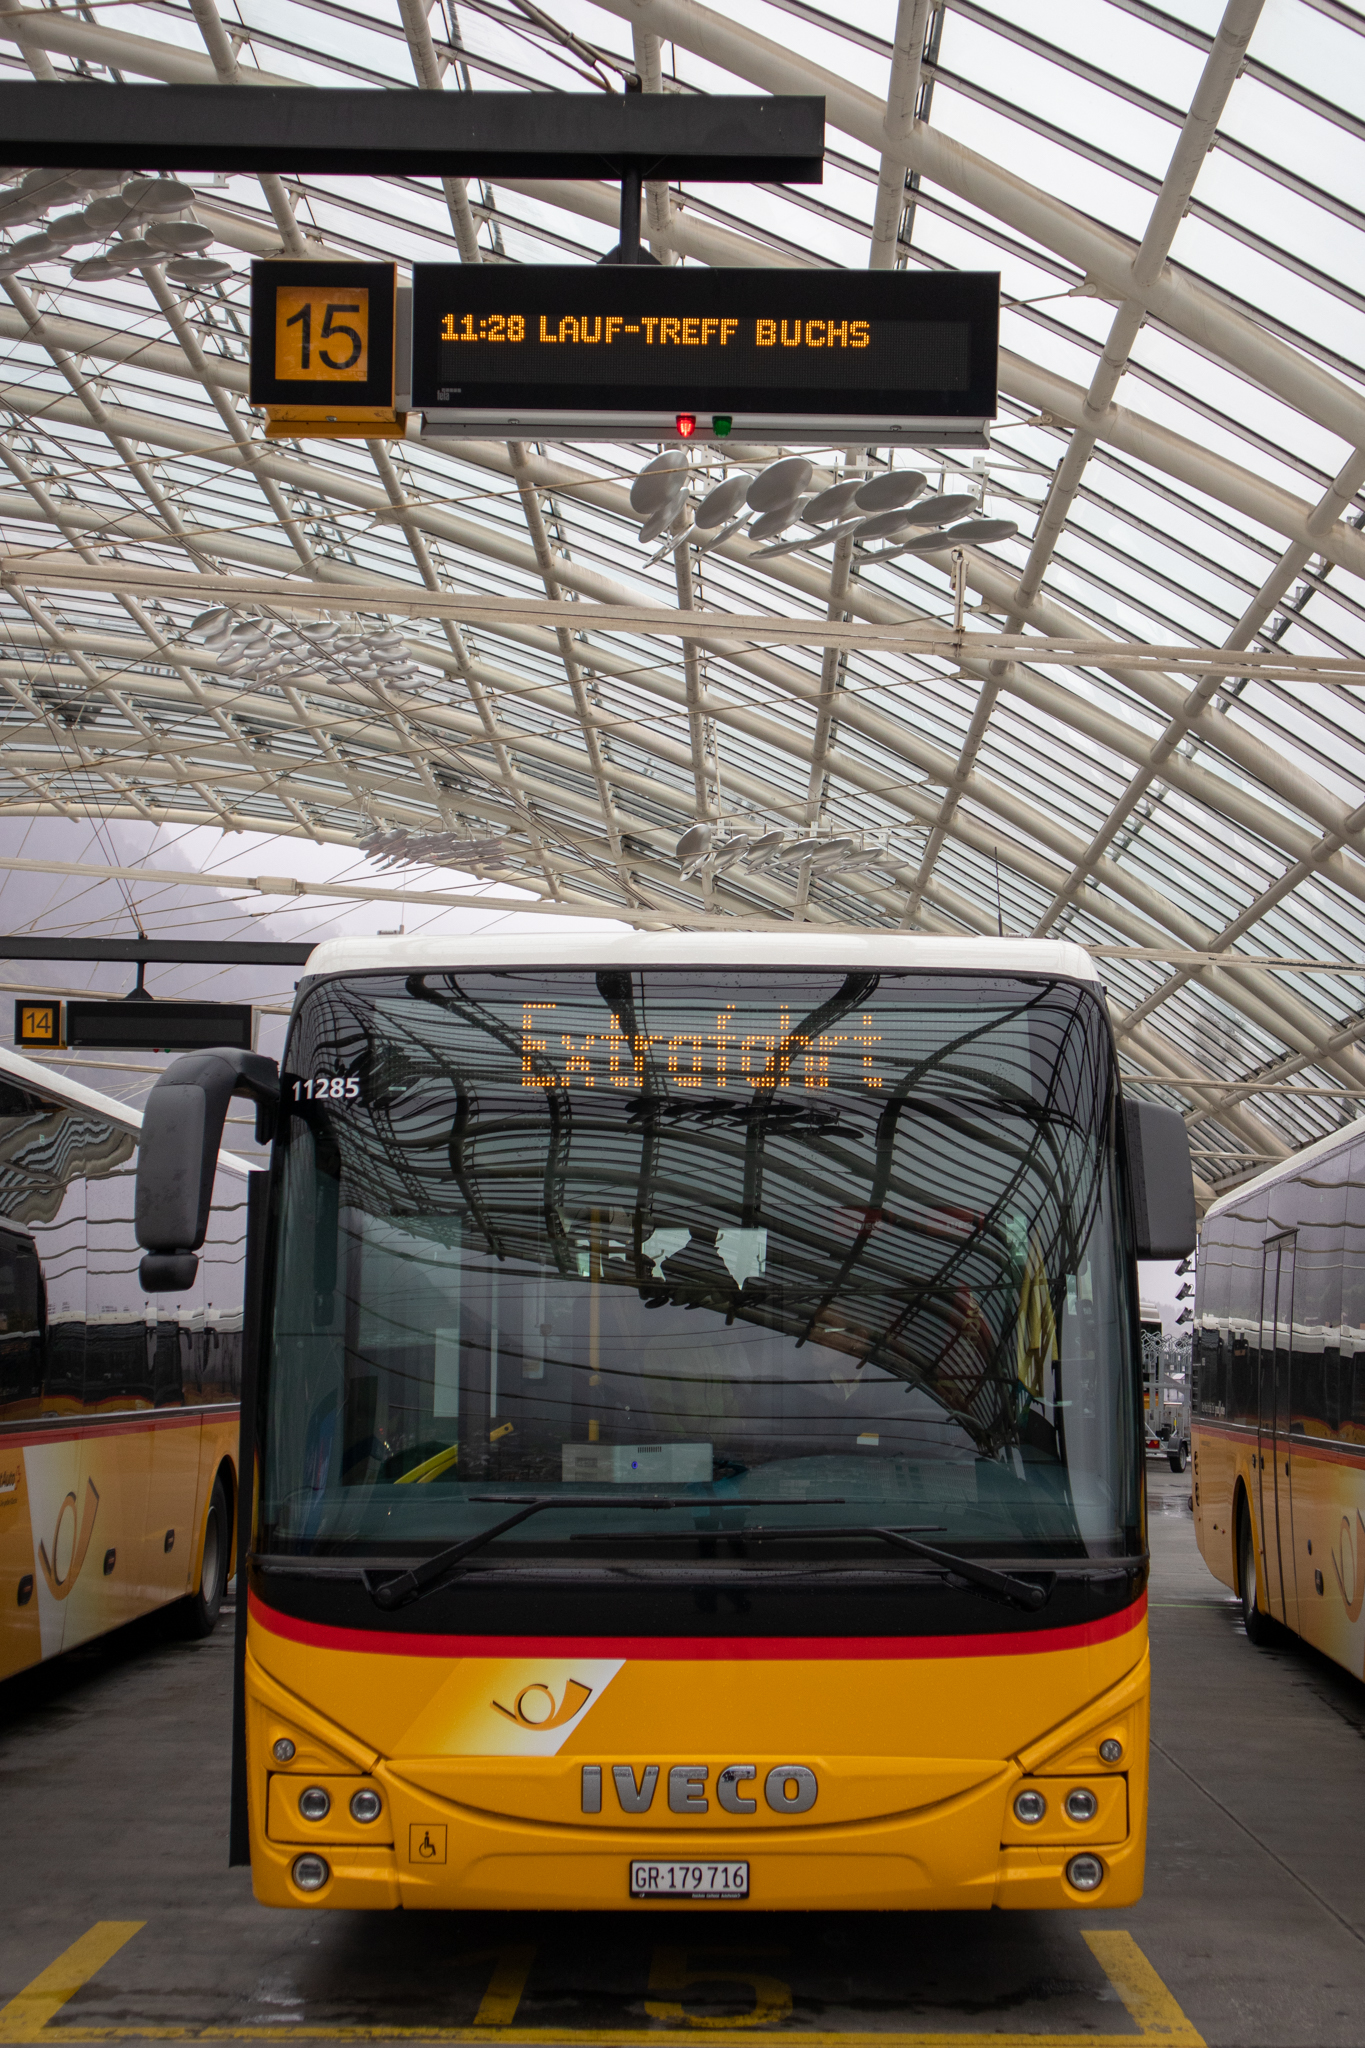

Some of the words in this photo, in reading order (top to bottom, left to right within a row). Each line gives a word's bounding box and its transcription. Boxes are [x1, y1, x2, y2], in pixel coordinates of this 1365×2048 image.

[286, 303, 362, 370] 15
[441, 313, 525, 342] 11:28
[540, 315, 738, 345] LAUF-TREFF
[756, 319, 870, 347] BUCHS
[25, 1011, 51, 1034] 14
[522, 1003, 882, 1087] Extrafahrt
[292, 1077, 360, 1101] 11285
[581, 1765, 819, 1814] IVECO
